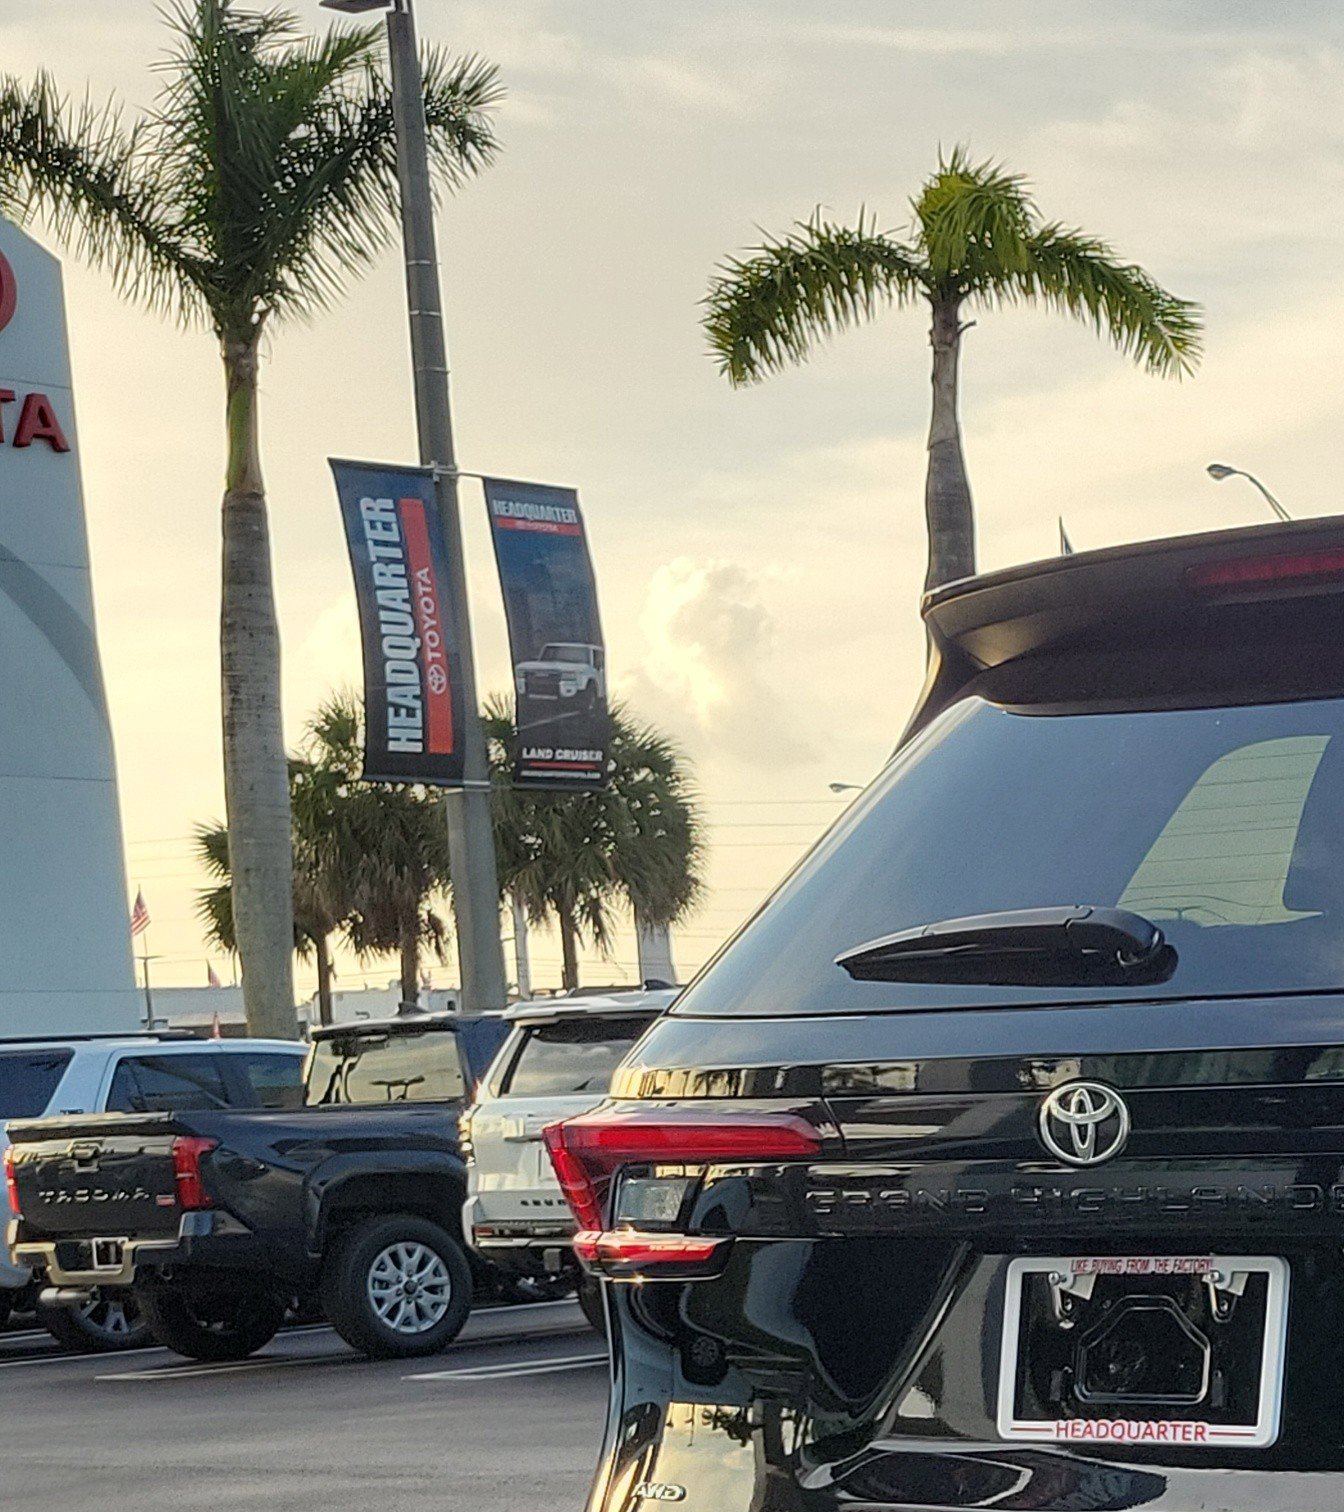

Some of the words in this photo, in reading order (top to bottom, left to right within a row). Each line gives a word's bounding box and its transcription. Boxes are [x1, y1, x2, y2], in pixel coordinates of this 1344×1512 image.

[494, 499, 578, 524] HEADQUARTER
[360, 497, 423, 753] HEADQUARTER
[412, 567, 442, 661] TOYOTA
[522, 747, 553, 759] LAND
[555, 749, 603, 762] CRUISER
[39, 1187, 150, 1204] TACOMA
[805, 1188, 991, 1214] GRAND
[1056, 1421, 1207, 1442] HEADQUARTER
[630, 1482, 687, 1502] AWD
